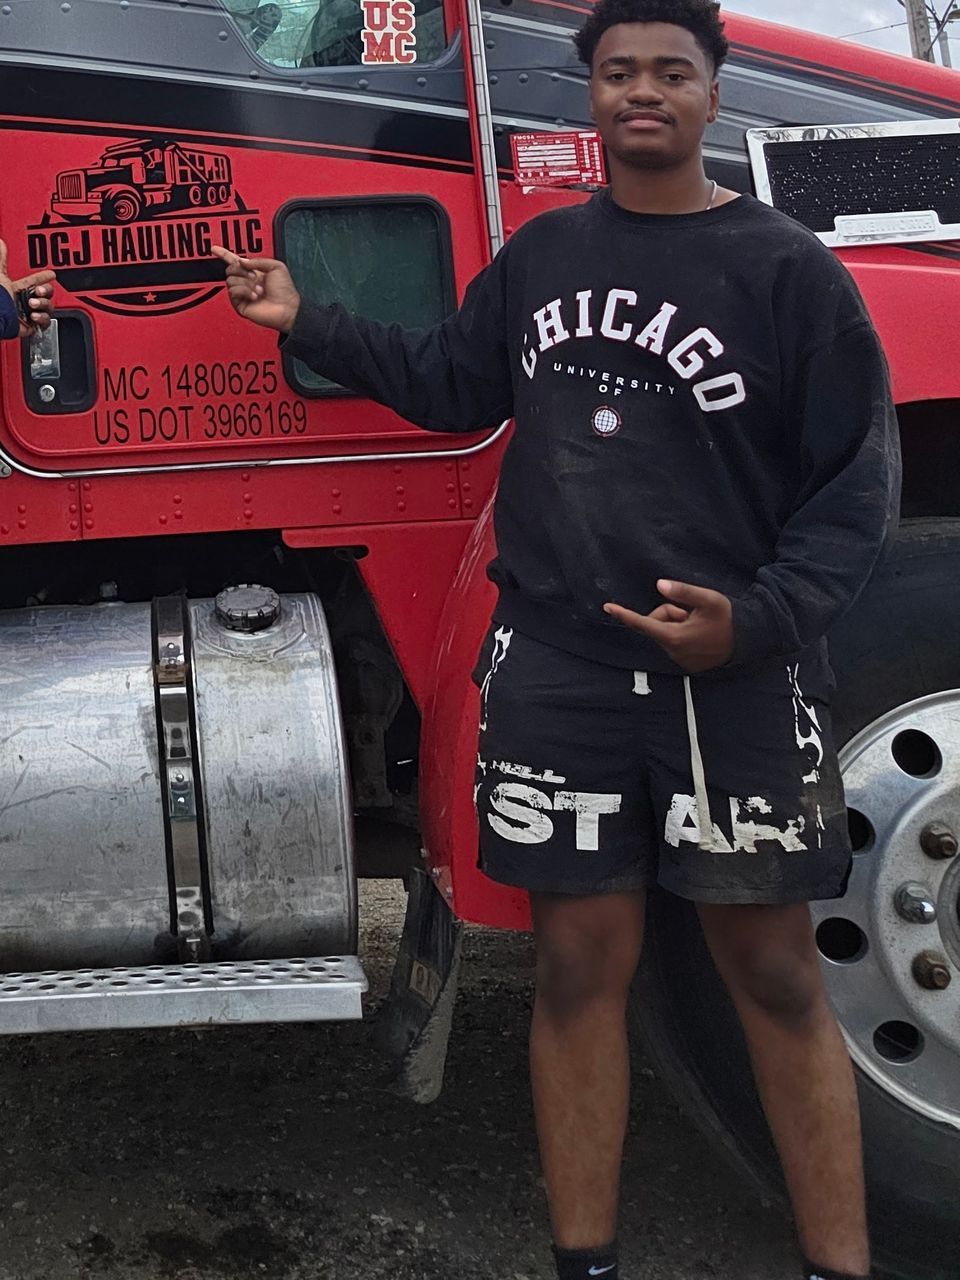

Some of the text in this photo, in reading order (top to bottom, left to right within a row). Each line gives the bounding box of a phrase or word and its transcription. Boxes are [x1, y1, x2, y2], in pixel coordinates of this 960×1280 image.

[362, 1, 413, 31] US
[363, 32, 415, 63] MC
[27, 218, 263, 269] DGJ HAULING LLC
[104, 360, 278, 401] MC 1480625
[553, 362, 675, 395] UNIVERSITY
[598, 383, 622, 397] OF
[93, 400, 307, 444] US DOT 3966169
